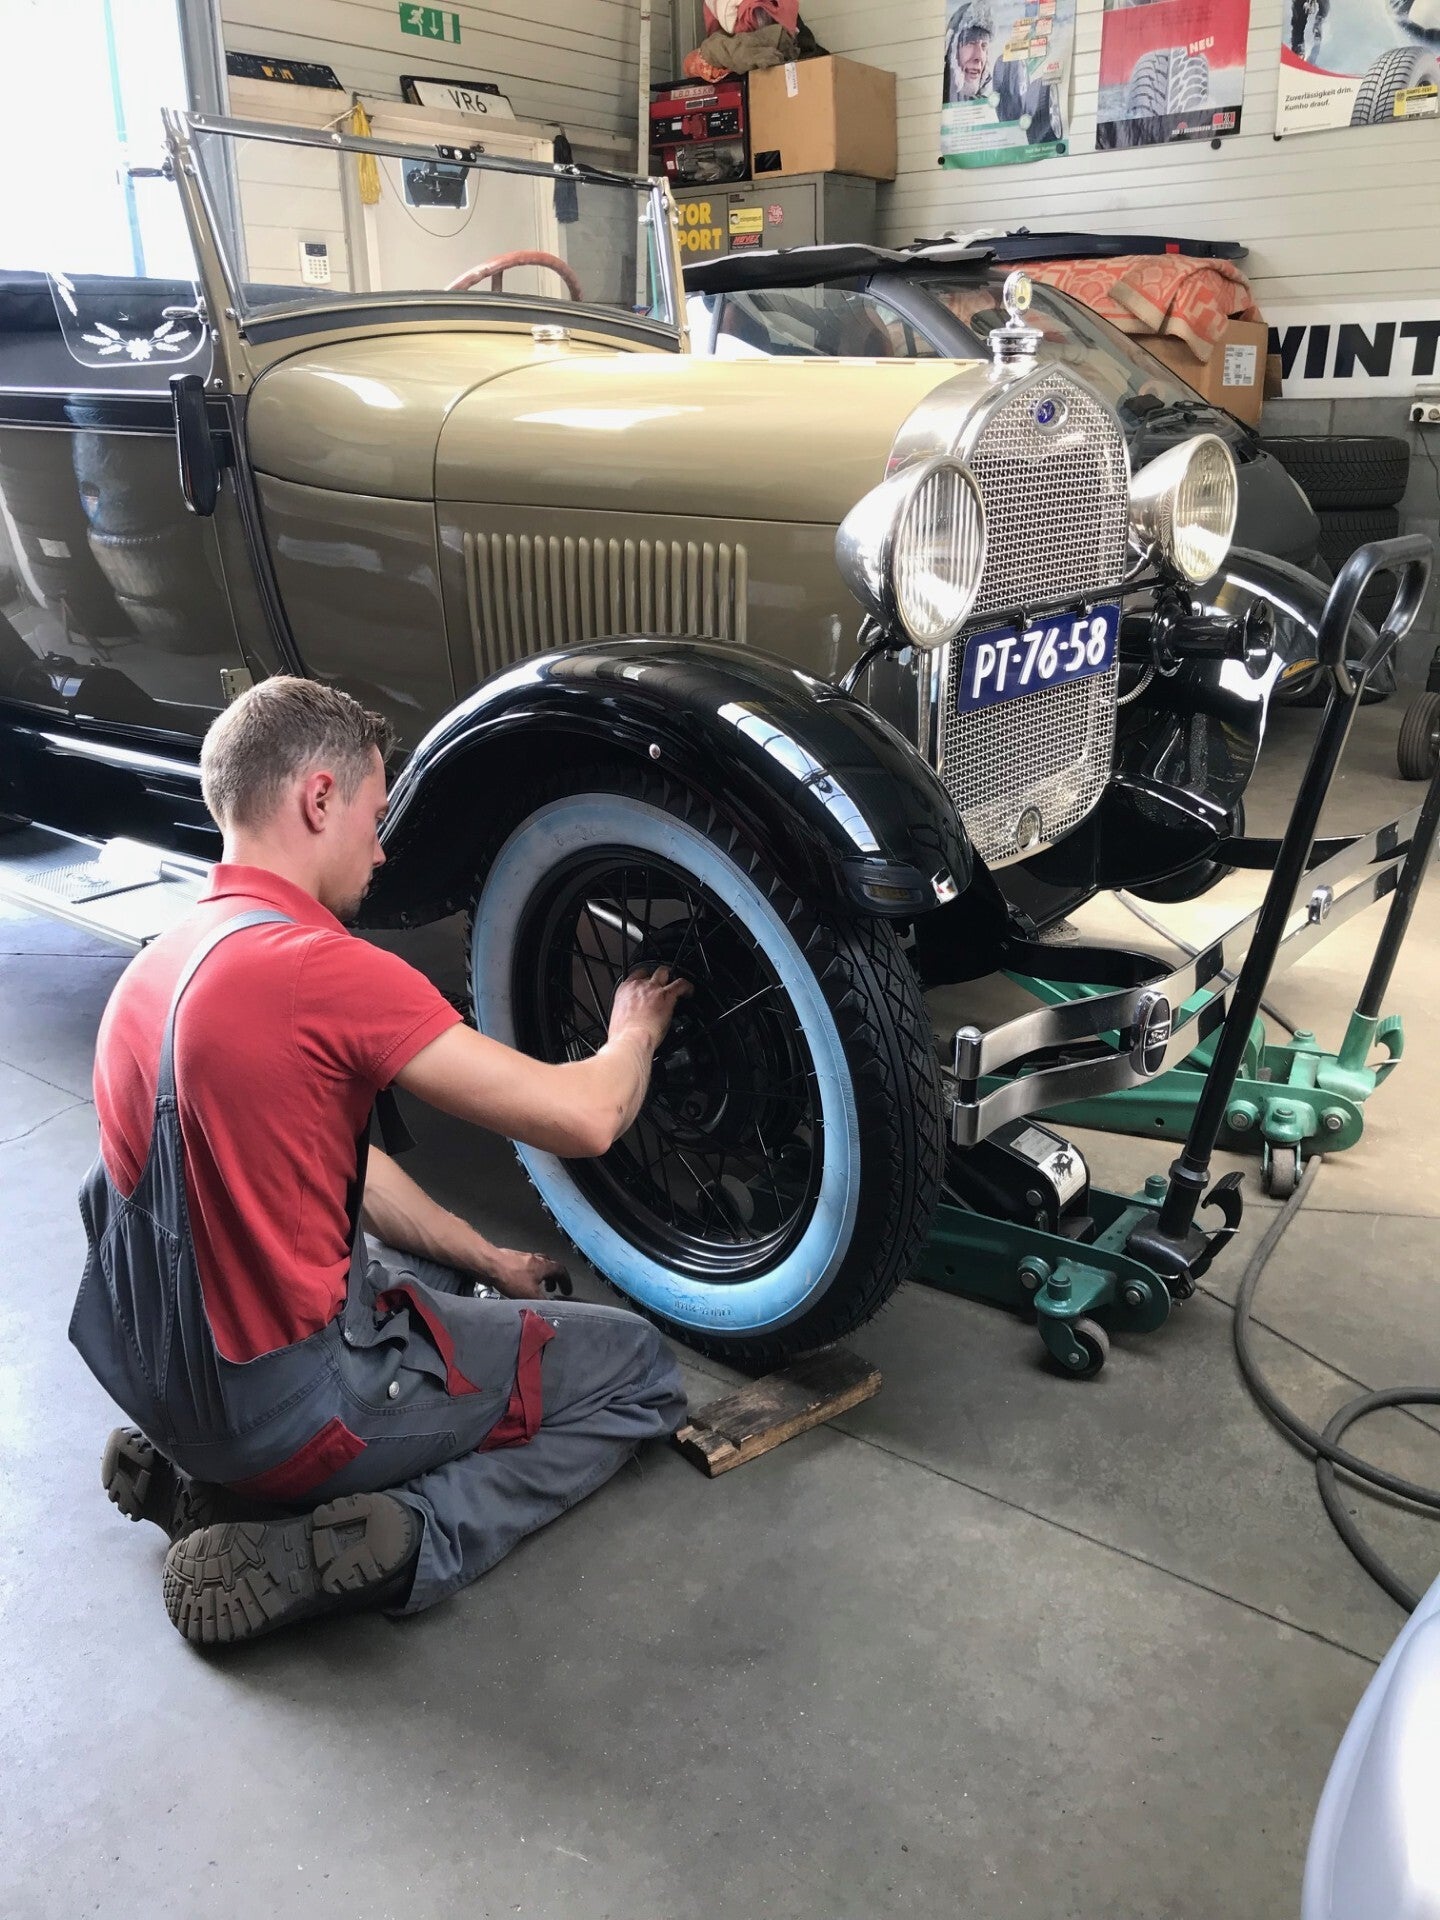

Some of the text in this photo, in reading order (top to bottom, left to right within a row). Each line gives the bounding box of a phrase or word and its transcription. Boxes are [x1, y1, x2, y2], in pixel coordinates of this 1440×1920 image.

[1189, 36, 1215, 54] NEU
[447, 88, 488, 113] VR6
[1285, 87, 1353, 102] Zuverlässigkeit drin.
[1284, 99, 1330, 111] Kumho drauf.
[972, 616, 1108, 699] PT-76-58
